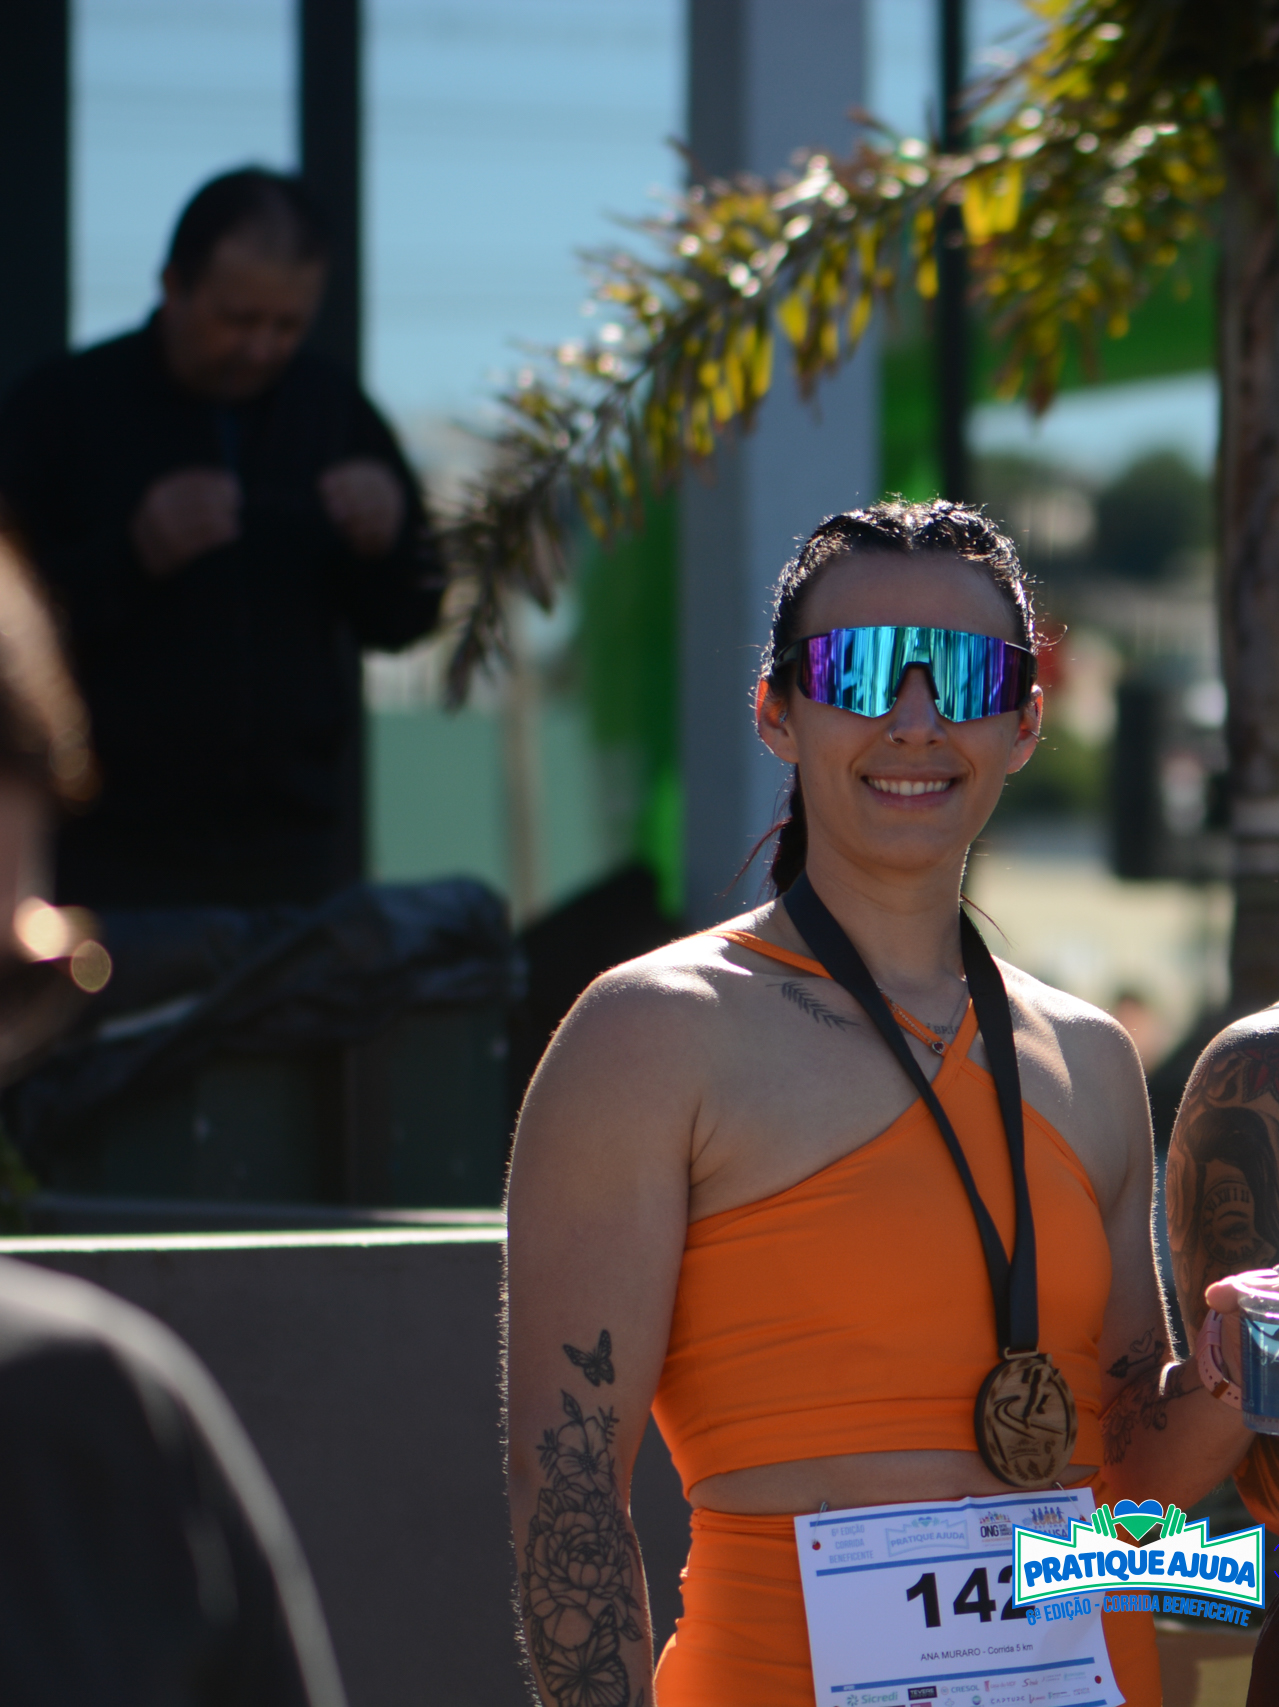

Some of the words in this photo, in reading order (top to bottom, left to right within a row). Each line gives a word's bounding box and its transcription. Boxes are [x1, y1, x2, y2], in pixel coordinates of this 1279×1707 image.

[980, 1524, 999, 1538] ONG
[835, 1538, 865, 1550] CORRIDA
[890, 1532, 934, 1547] PRATIQUE
[936, 1530, 965, 1541] AJUDA
[829, 1550, 874, 1564] BENEFICENTE
[921, 1651, 940, 1661] ANA
[941, 1648, 981, 1659] MURARO
[988, 1645, 1014, 1655] Corrida
[1016, 1644, 1021, 1652] 5
[1022, 1643, 1033, 1651] km
[950, 1684, 980, 1693] CRESOL
[861, 1691, 898, 1704] Sicredi
